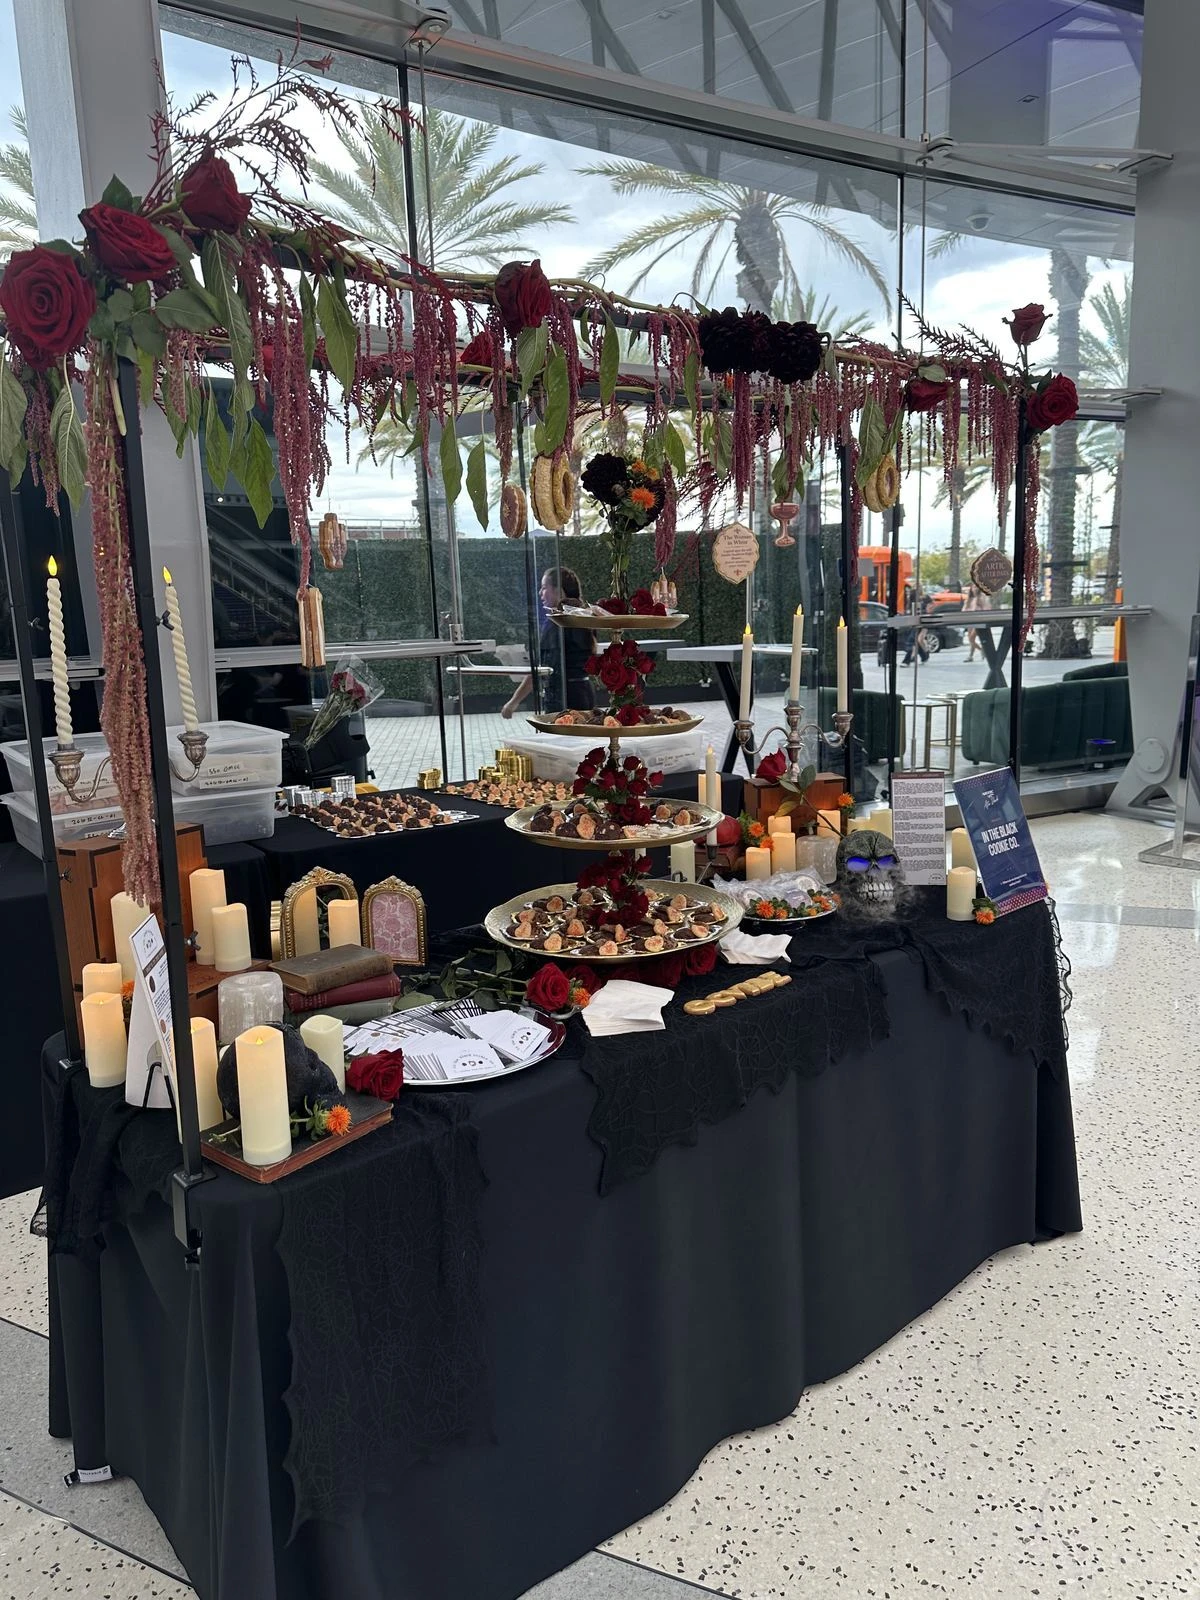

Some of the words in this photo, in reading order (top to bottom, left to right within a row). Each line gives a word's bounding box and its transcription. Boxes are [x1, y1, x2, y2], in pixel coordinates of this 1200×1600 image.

[981, 830, 989, 843] IN
[987, 827, 1001, 841] THE
[998, 822, 1018, 838] BLACK
[988, 839, 1010, 856] COOKIE
[1008, 837, 1020, 850] CO.
